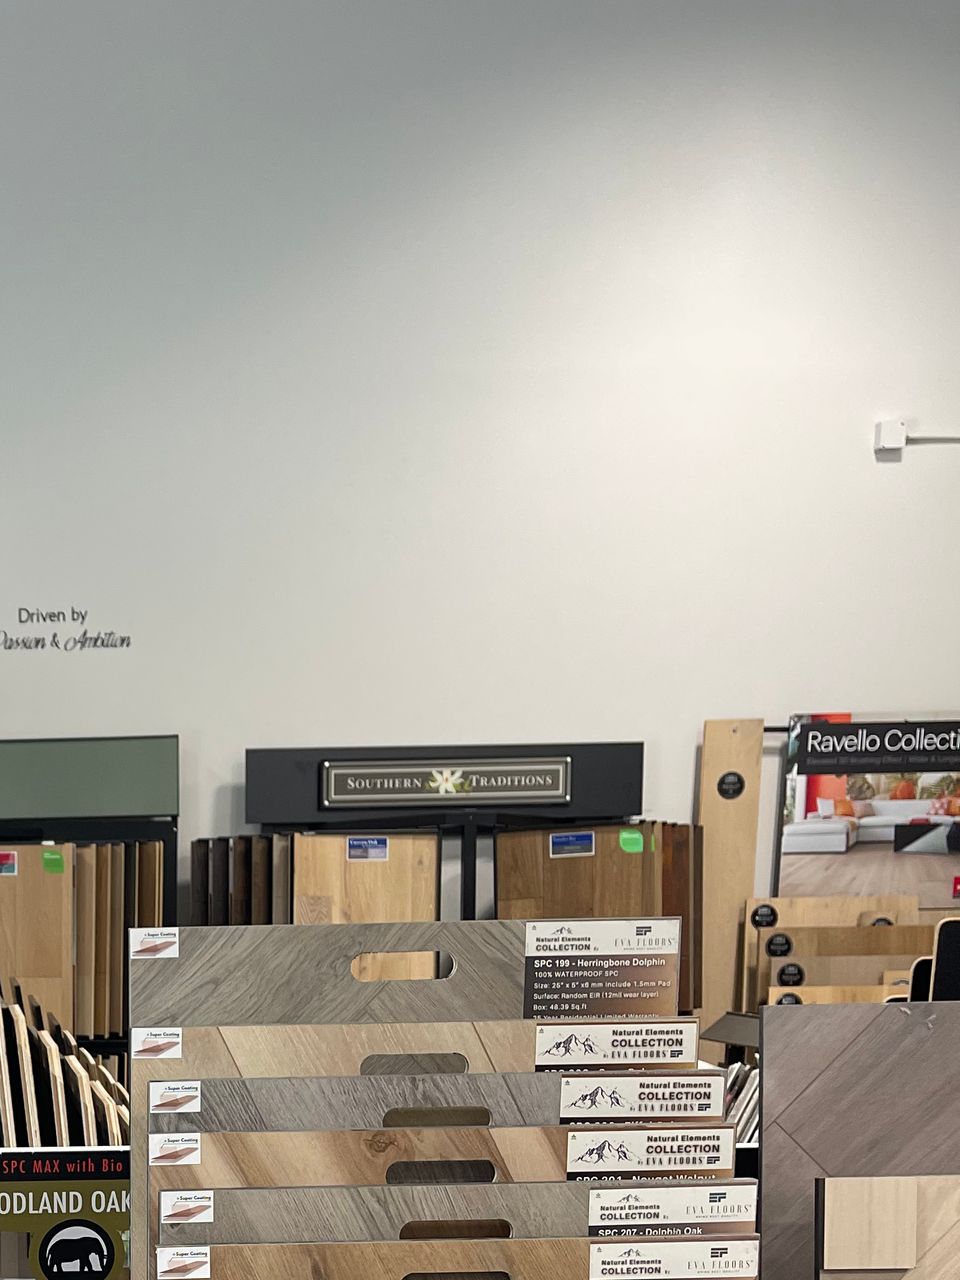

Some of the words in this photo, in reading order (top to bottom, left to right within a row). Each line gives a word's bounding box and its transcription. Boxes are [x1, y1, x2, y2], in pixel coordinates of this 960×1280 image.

[18, 608, 66, 623] Driven
[72, 606, 88, 624] by
[51, 632, 60, 649] &
[64, 629, 130, 651] Ambition
[808, 729, 880, 752] Ravello
[347, 777, 422, 789] SOUTHERN
[470, 775, 552, 787] TRADITIONS
[534, 960, 552, 968] SPC
[577, 959, 630, 968] Herringbone
[633, 958, 665, 967] Dolphin
[611, 1039, 683, 1047] COLLECTION
[639, 1092, 711, 1100] COLLECTION
[2, 1160, 25, 1174] SPC
[33, 1159, 60, 1173] MAX
[67, 1158, 95, 1172] with
[102, 1159, 122, 1172] Bio
